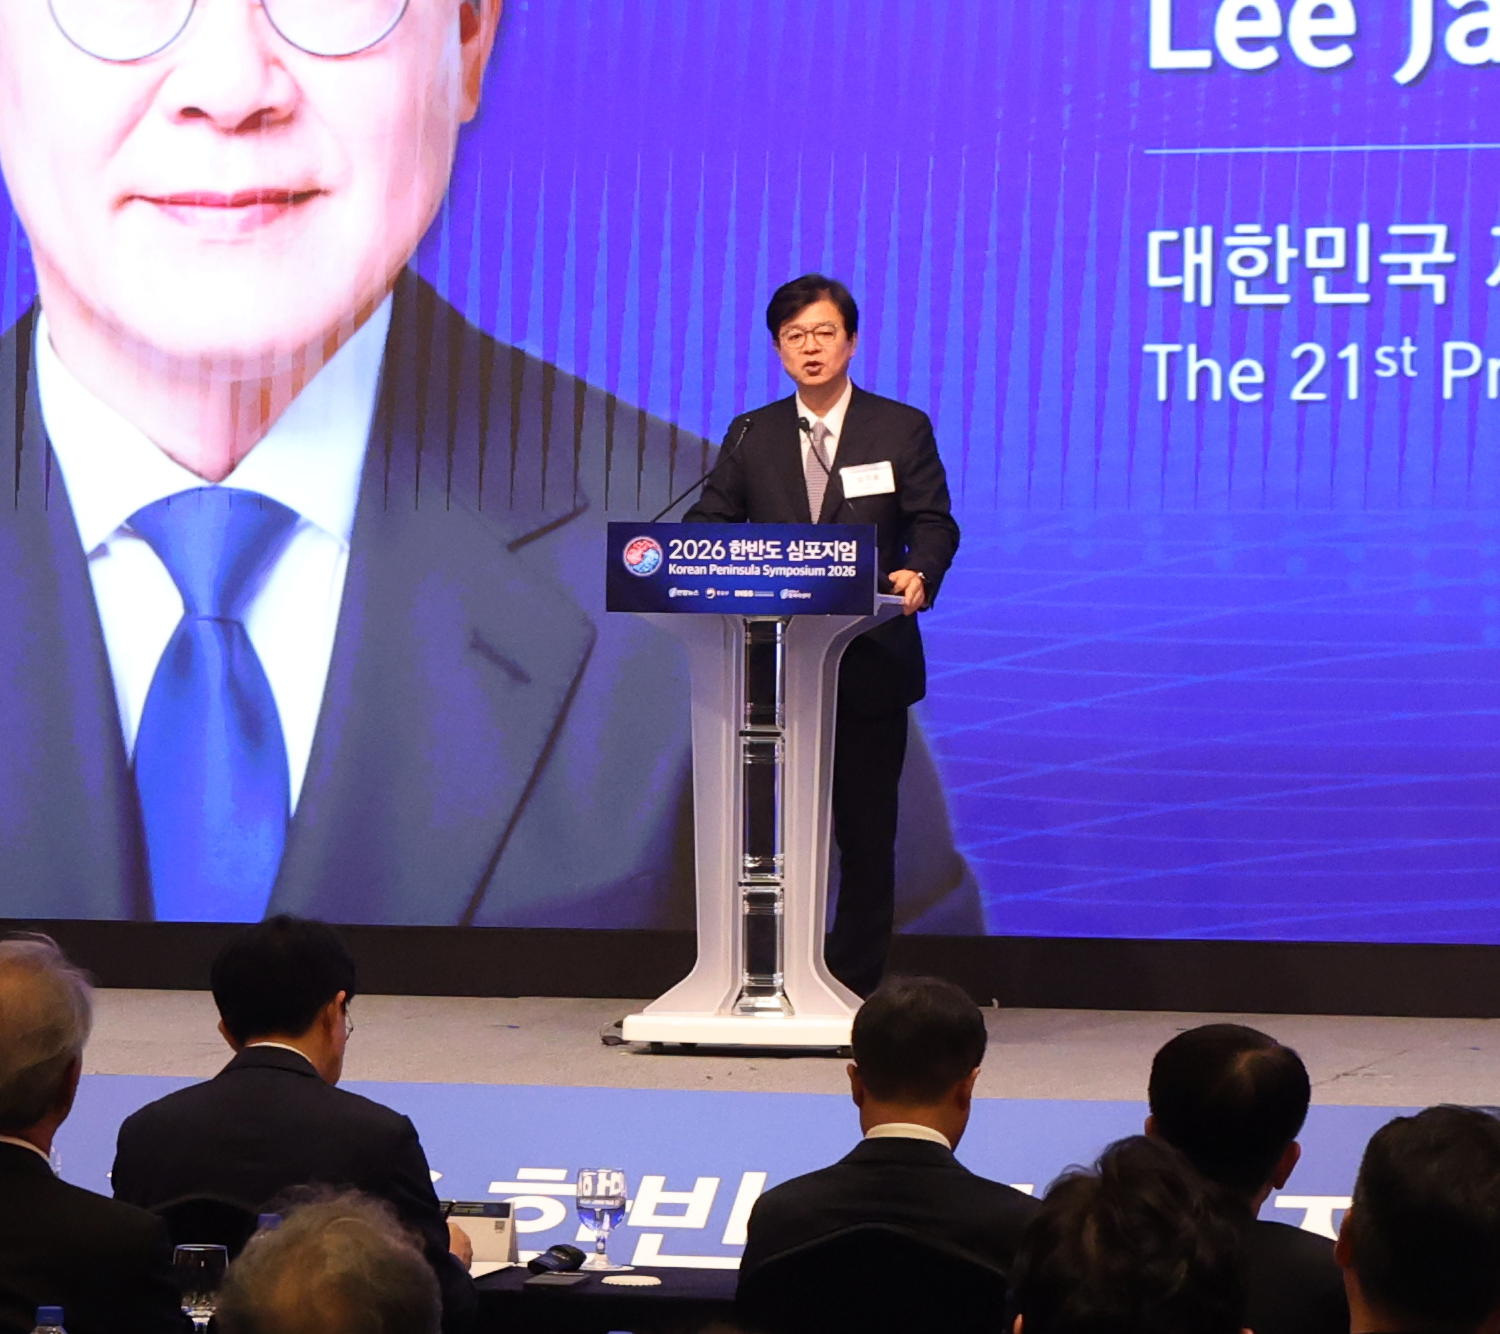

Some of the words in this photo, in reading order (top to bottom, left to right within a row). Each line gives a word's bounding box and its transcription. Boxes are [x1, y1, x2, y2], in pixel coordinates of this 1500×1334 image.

[1148, 223, 1456, 306] 대한민국
[1143, 344, 1264, 402] The
[1290, 337, 1418, 400] 21st
[668, 539, 726, 561] 2026
[728, 539, 783, 561] 한반도
[786, 539, 857, 562] 심포지엄
[668, 564, 707, 576] Korean
[709, 564, 761, 576] Peninsula
[762, 565, 826, 578] Symposium
[827, 565, 857, 577] 2026
[488, 1167, 767, 1269] 한반
